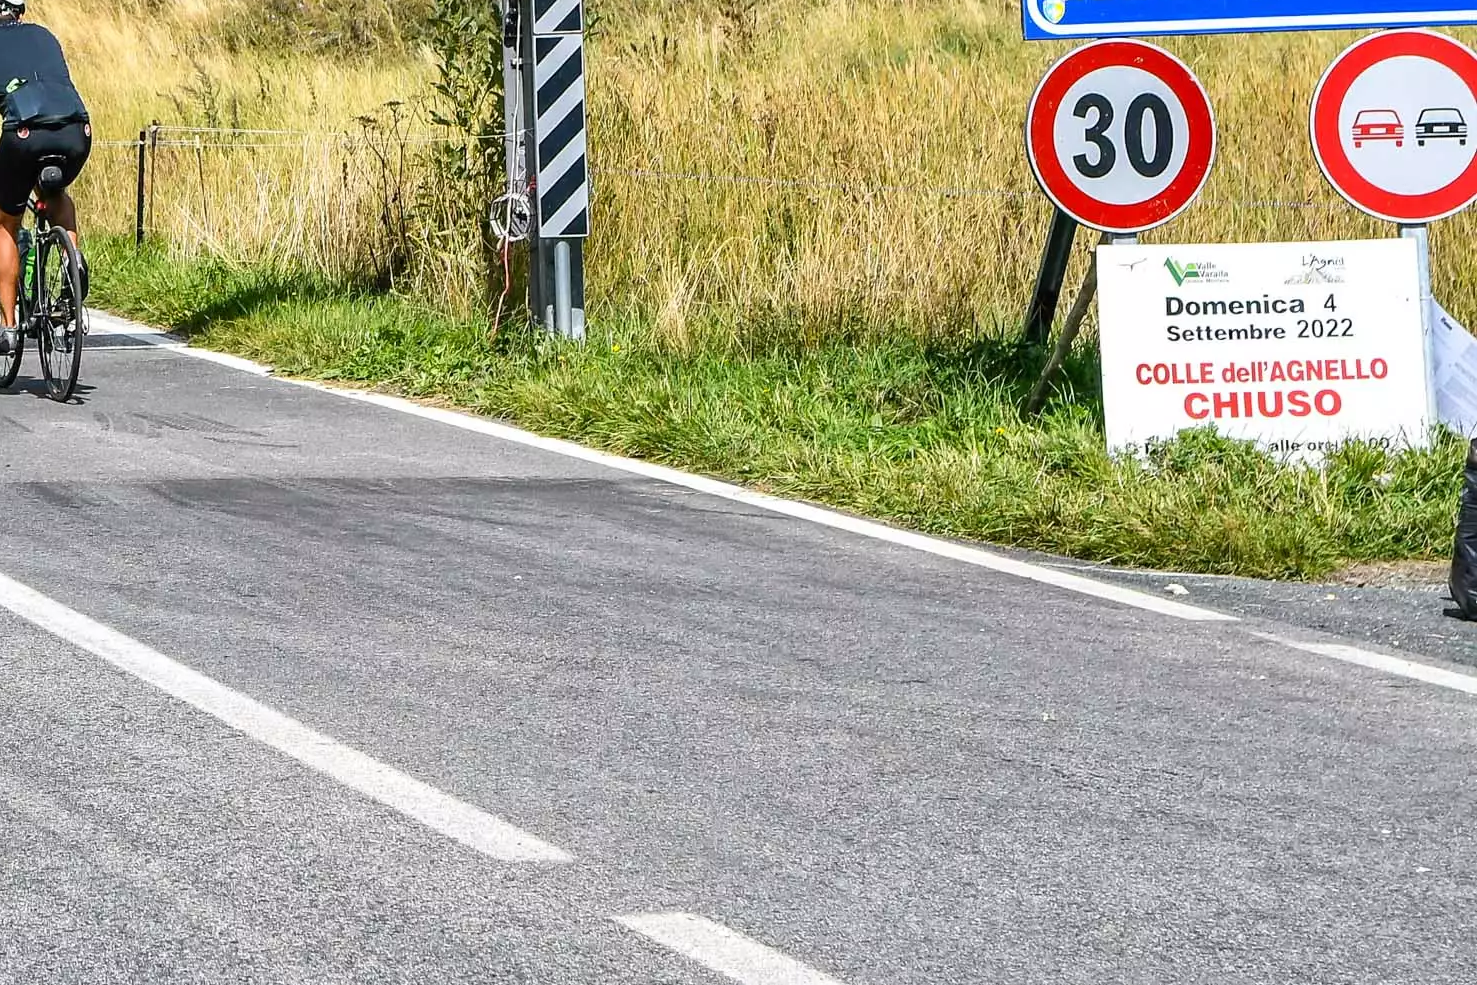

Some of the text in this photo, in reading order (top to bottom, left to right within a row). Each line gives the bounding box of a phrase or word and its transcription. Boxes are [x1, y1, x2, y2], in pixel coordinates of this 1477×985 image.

[1071, 92, 1174, 179] 30
[1195, 261, 1217, 270] Valle
[1165, 293, 1337, 316] Domenica 4
[1167, 318, 1354, 342] Settembre 2022
[1135, 358, 1388, 385] COLLE dell'AGNELLO
[1184, 389, 1342, 420] CHIUSO
[1268, 440, 1300, 453] alle
